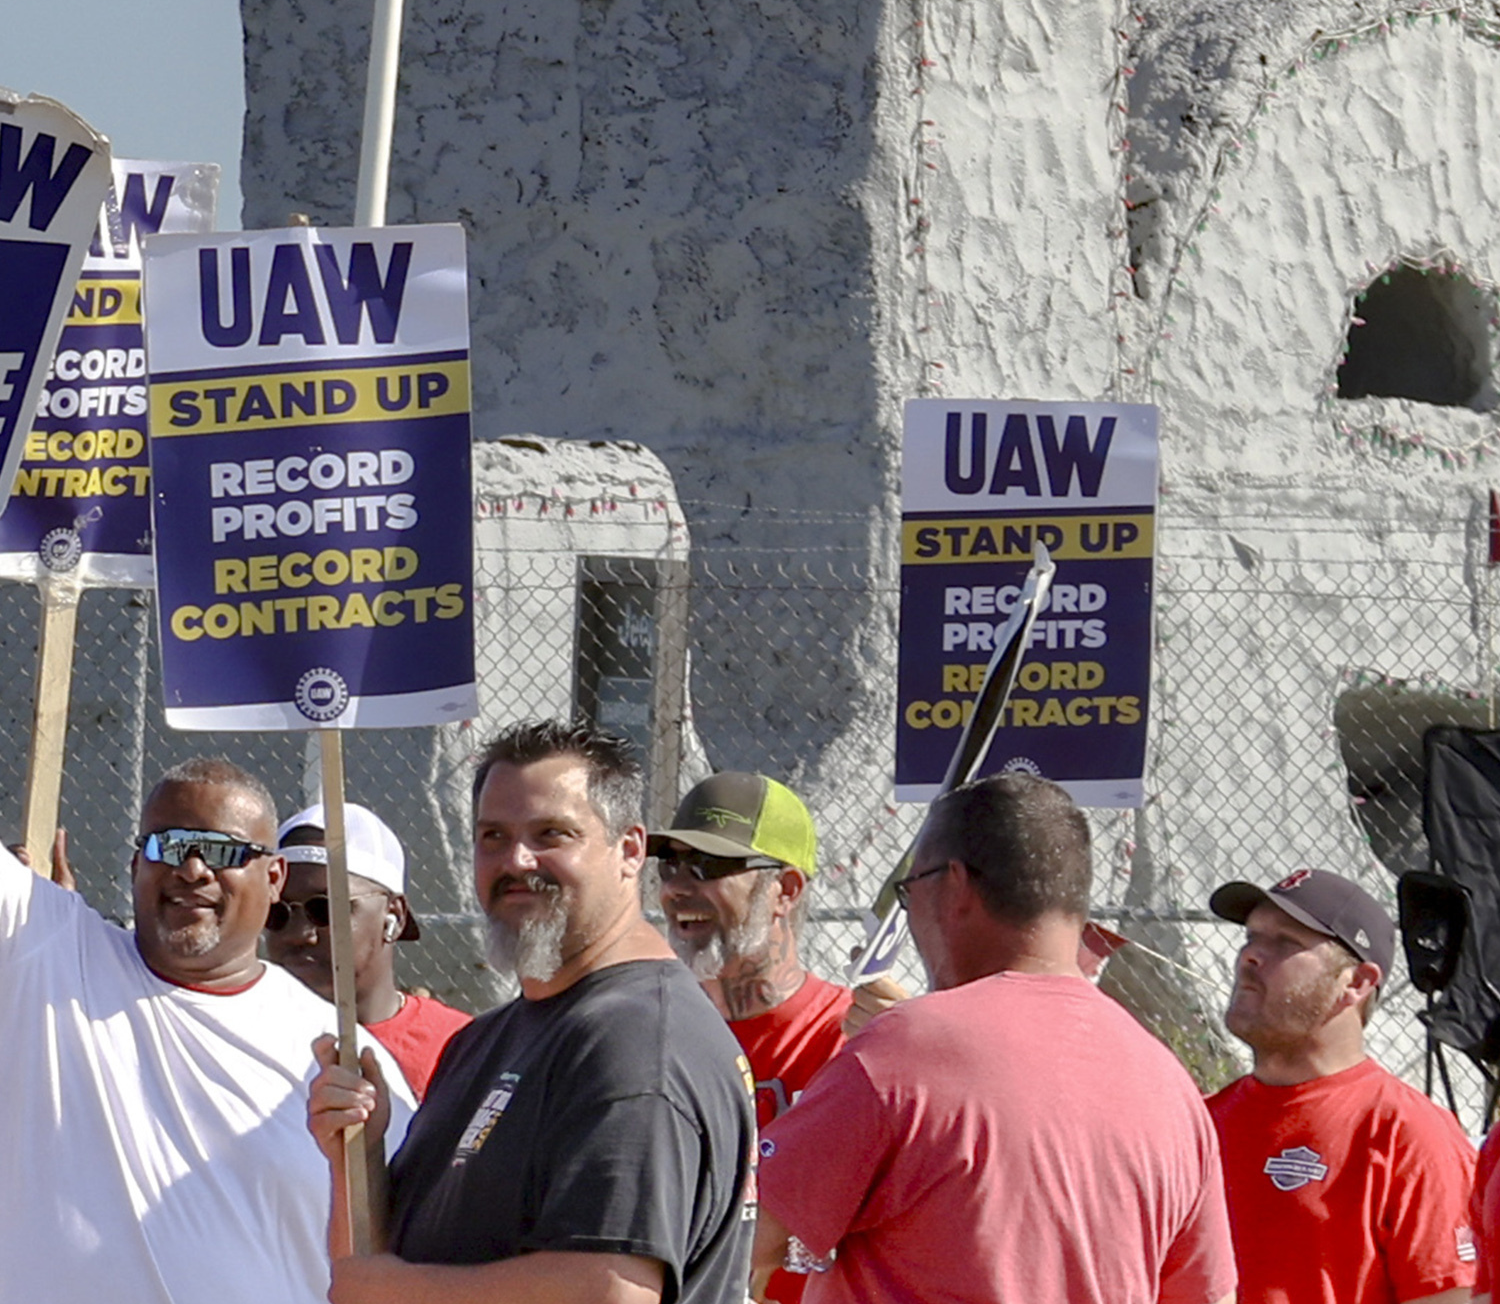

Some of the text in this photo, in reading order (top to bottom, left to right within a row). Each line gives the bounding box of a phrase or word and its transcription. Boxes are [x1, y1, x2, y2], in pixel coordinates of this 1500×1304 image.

[199, 242, 413, 347] UAW
[48, 349, 146, 381] CORD
[37, 385, 147, 418] ROFITS
[170, 372, 448, 427] STAND UP
[24, 429, 144, 461] ECORD
[944, 412, 1117, 497] UAW
[11, 465, 152, 497] NTRACT
[210, 450, 414, 497] RECORD
[212, 495, 417, 542] PROFITS
[915, 522, 1138, 557] STAND UP
[214, 546, 417, 594] RECORD
[171, 583, 464, 640] CONTRACTS
[944, 584, 1107, 615] RECRD
[942, 619, 1107, 651] PRFITS
[943, 661, 1105, 692] REORD
